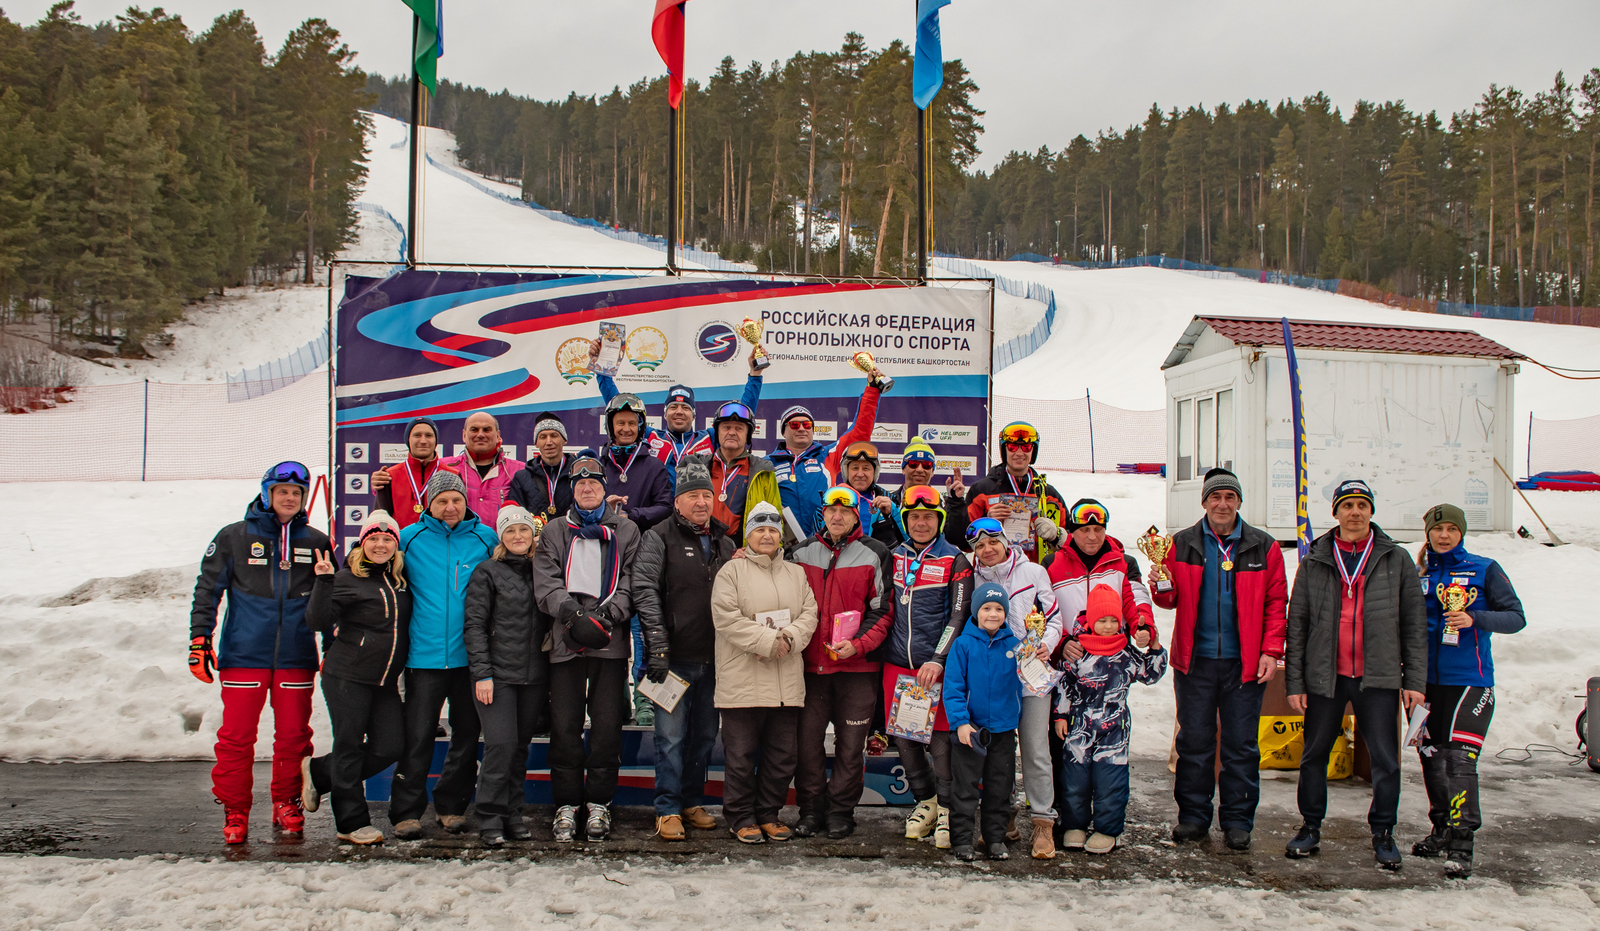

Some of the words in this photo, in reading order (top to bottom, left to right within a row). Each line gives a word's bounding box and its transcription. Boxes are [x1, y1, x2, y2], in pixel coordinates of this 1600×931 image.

[761, 310, 870, 328] РОССИЙСКАЯ
[875, 314, 975, 334] ФЕДЕРАЦИЯ
[766, 331, 904, 349] ГОРНОЛЫЖНОГО
[909, 335, 970, 352] СПОРТА
[768, 353, 818, 362] ЕГИОНАЛЬНОЕ
[818, 355, 854, 363] ОТДЕЛЕНИ
[874, 356, 916, 365] ЕСПУБЛИКЕ
[916, 358, 971, 367] БАШКОРТОСТАН
[936, 460, 972, 468] АВТОКОР
[889, 764, 910, 794] 3
